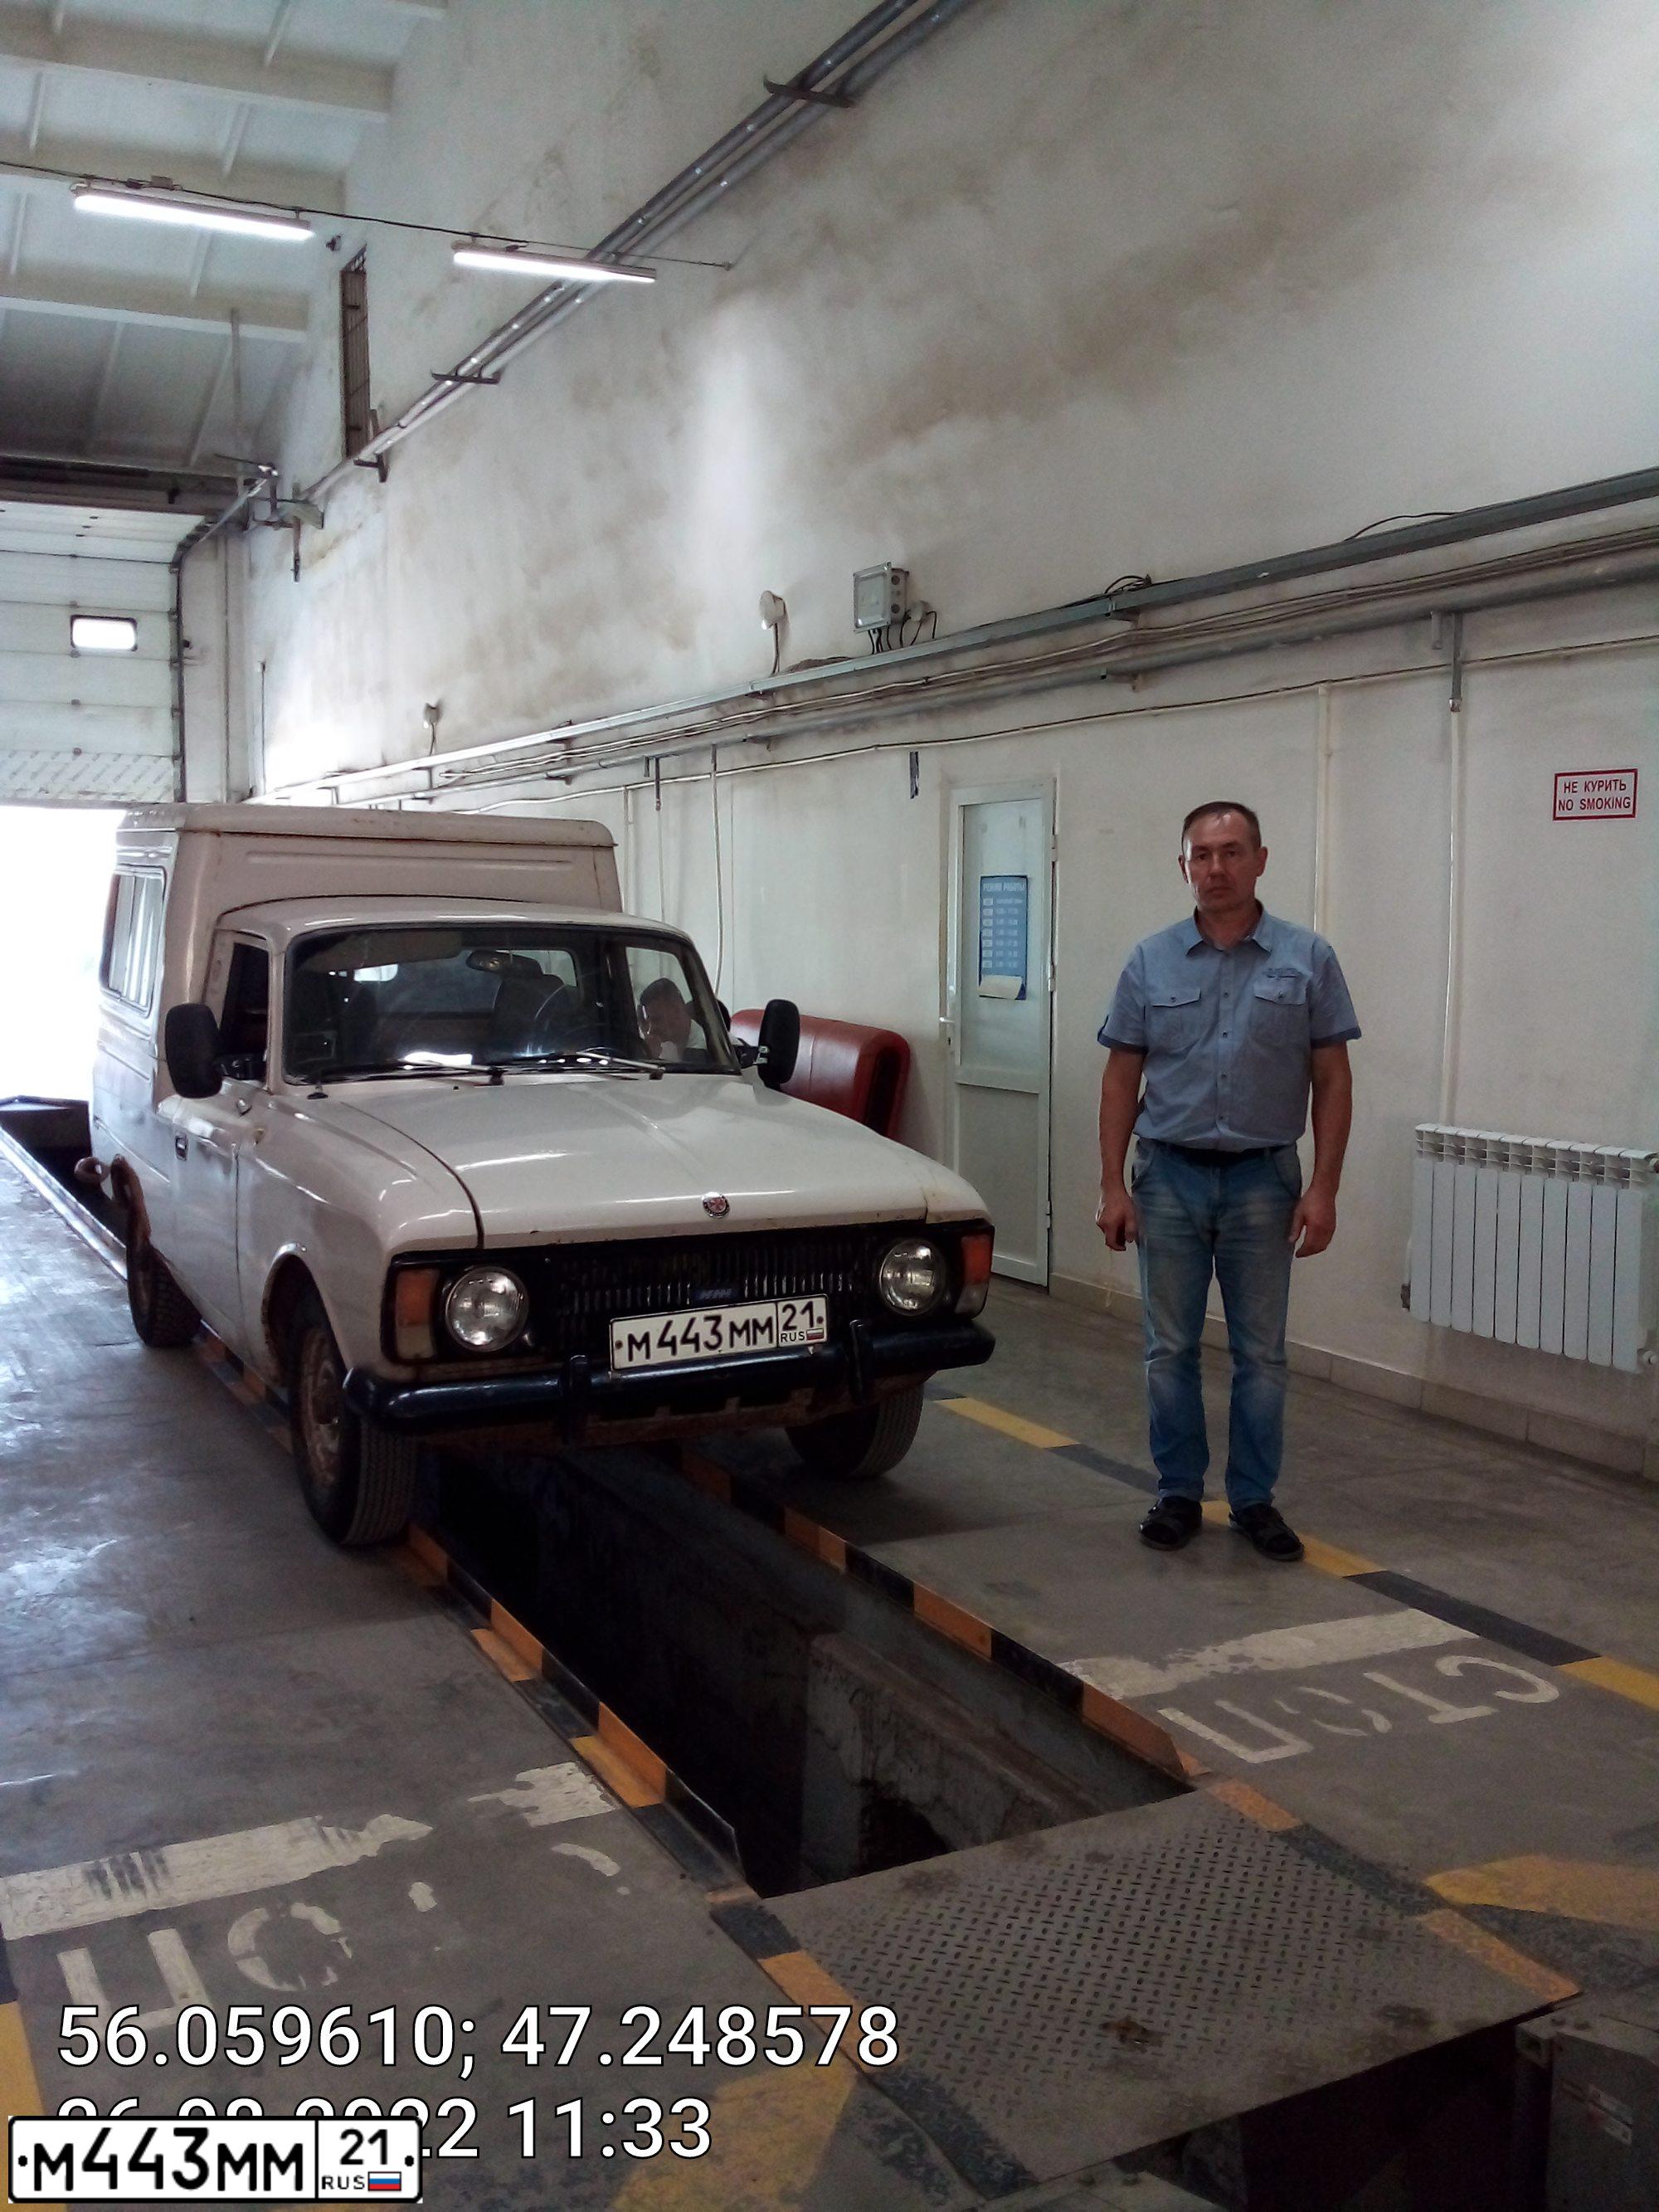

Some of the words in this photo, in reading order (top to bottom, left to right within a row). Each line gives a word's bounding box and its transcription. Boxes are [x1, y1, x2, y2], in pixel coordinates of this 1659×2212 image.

[1564, 782, 1579, 794] НЕ
[1584, 779, 1627, 792] КУРИТЬ
[1558, 799, 1574, 811] NO
[1579, 797, 1632, 810] SMOKING
[781, 1300, 815, 1331] 21
[780, 1330, 805, 1342] RUS
